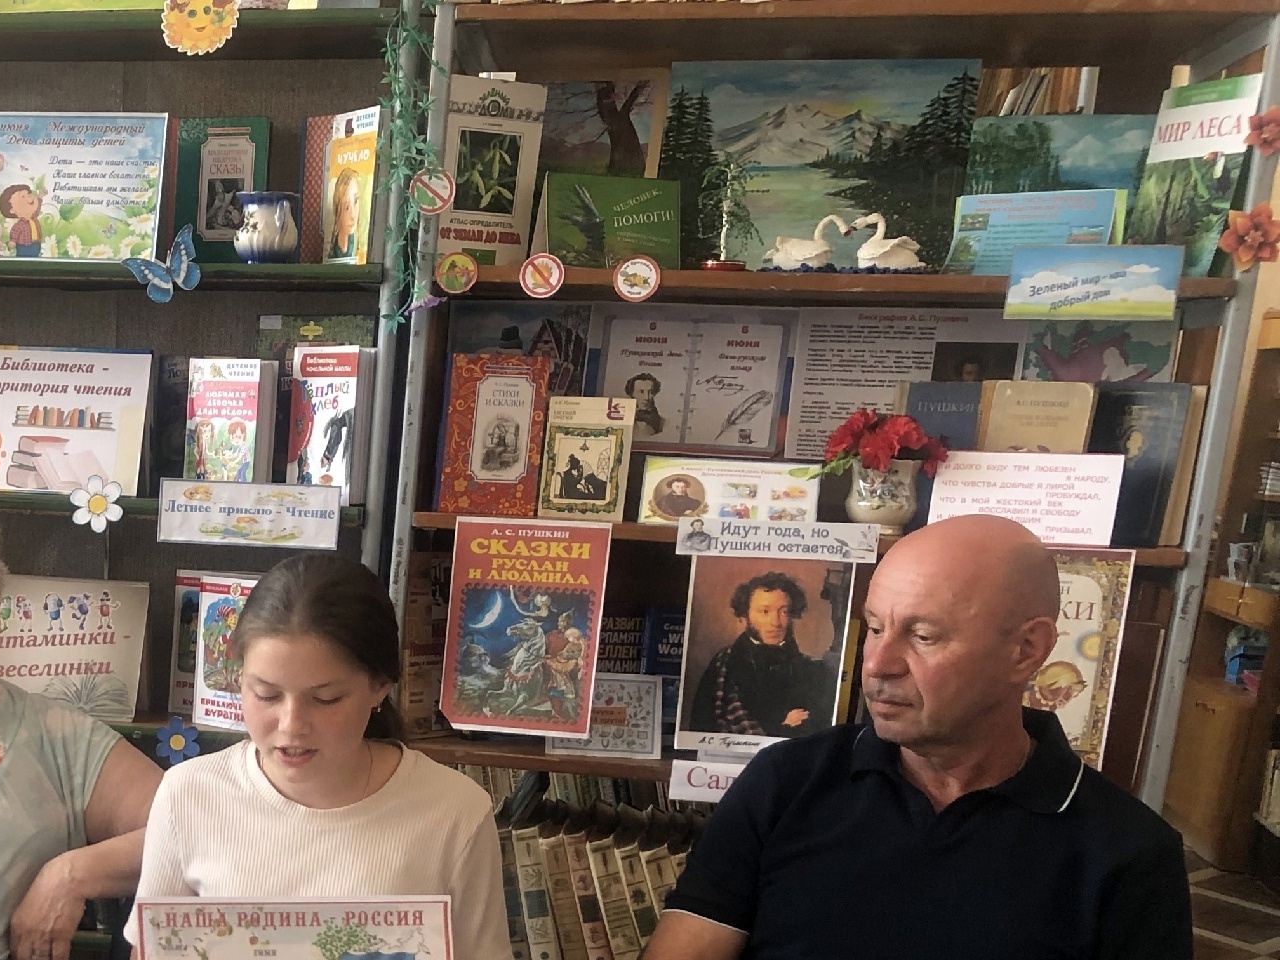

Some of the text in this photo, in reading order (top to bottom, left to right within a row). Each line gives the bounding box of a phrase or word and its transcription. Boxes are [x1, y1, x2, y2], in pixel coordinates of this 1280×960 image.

[0, 122, 30, 132] июня
[46, 121, 146, 134] Международный
[1154, 114, 1243, 145] МИР ЛЕСА
[6, 134, 126, 148] День защиты детей
[48, 155, 73, 165] Дети
[338, 149, 370, 165] ЧУЧЕЛО
[209, 163, 245, 175] СКАЗЫ
[449, 217, 514, 229] АТЛАС-ОПРЕДЕЛИТЕЛЬ
[613, 209, 676, 228] ПОМОГИ!
[1029, 269, 1127, 298] Зеленый мир наш
[1049, 287, 1111, 313] добрый дом
[858, 312, 908, 323] Биография
[649, 322, 657, 331] 6
[742, 326, 749, 334] 6
[0, 356, 95, 374] Библиотека
[73, 383, 132, 397] чтения
[205, 390, 247, 398] ЛЮБИМАЯ
[300, 380, 350, 404] Тёплый
[492, 389, 520, 398] СТИХИ
[206, 399, 244, 407] ДЕВОЧКА
[310, 395, 339, 416] хлеб
[485, 398, 525, 407] И СКАЗКИ
[918, 401, 974, 413] ПУШКИН
[952, 463, 982, 471] ДОЛГО
[986, 464, 1009, 472] БУДУ
[1034, 465, 1077, 473] ЛЮБЕЗЕН
[999, 482, 1034, 490] ДОБРЫЕ
[1045, 482, 1075, 491] ЛИРОЙ
[996, 498, 1042, 506] ЖЕСТОКИЙ
[164, 499, 212, 514] Летнее
[218, 504, 273, 517] приклю
[286, 505, 336, 519] Чтение
[978, 506, 1029, 514] ВОССЛАВИЛ
[1040, 509, 1081, 517] СВОБОДУ
[505, 529, 515, 537] С.
[518, 529, 570, 539] ПУШКИН
[720, 520, 830, 539] Идут года, но
[470, 538, 591, 559] СКАЗКИ
[710, 536, 771, 552] Пушкин
[491, 558, 570, 572] РУСЛАН
[468, 568, 590, 585] И ЛЮДМИЛА
[164, 910, 425, 930] НАША РОДИНА РОССИЯ
